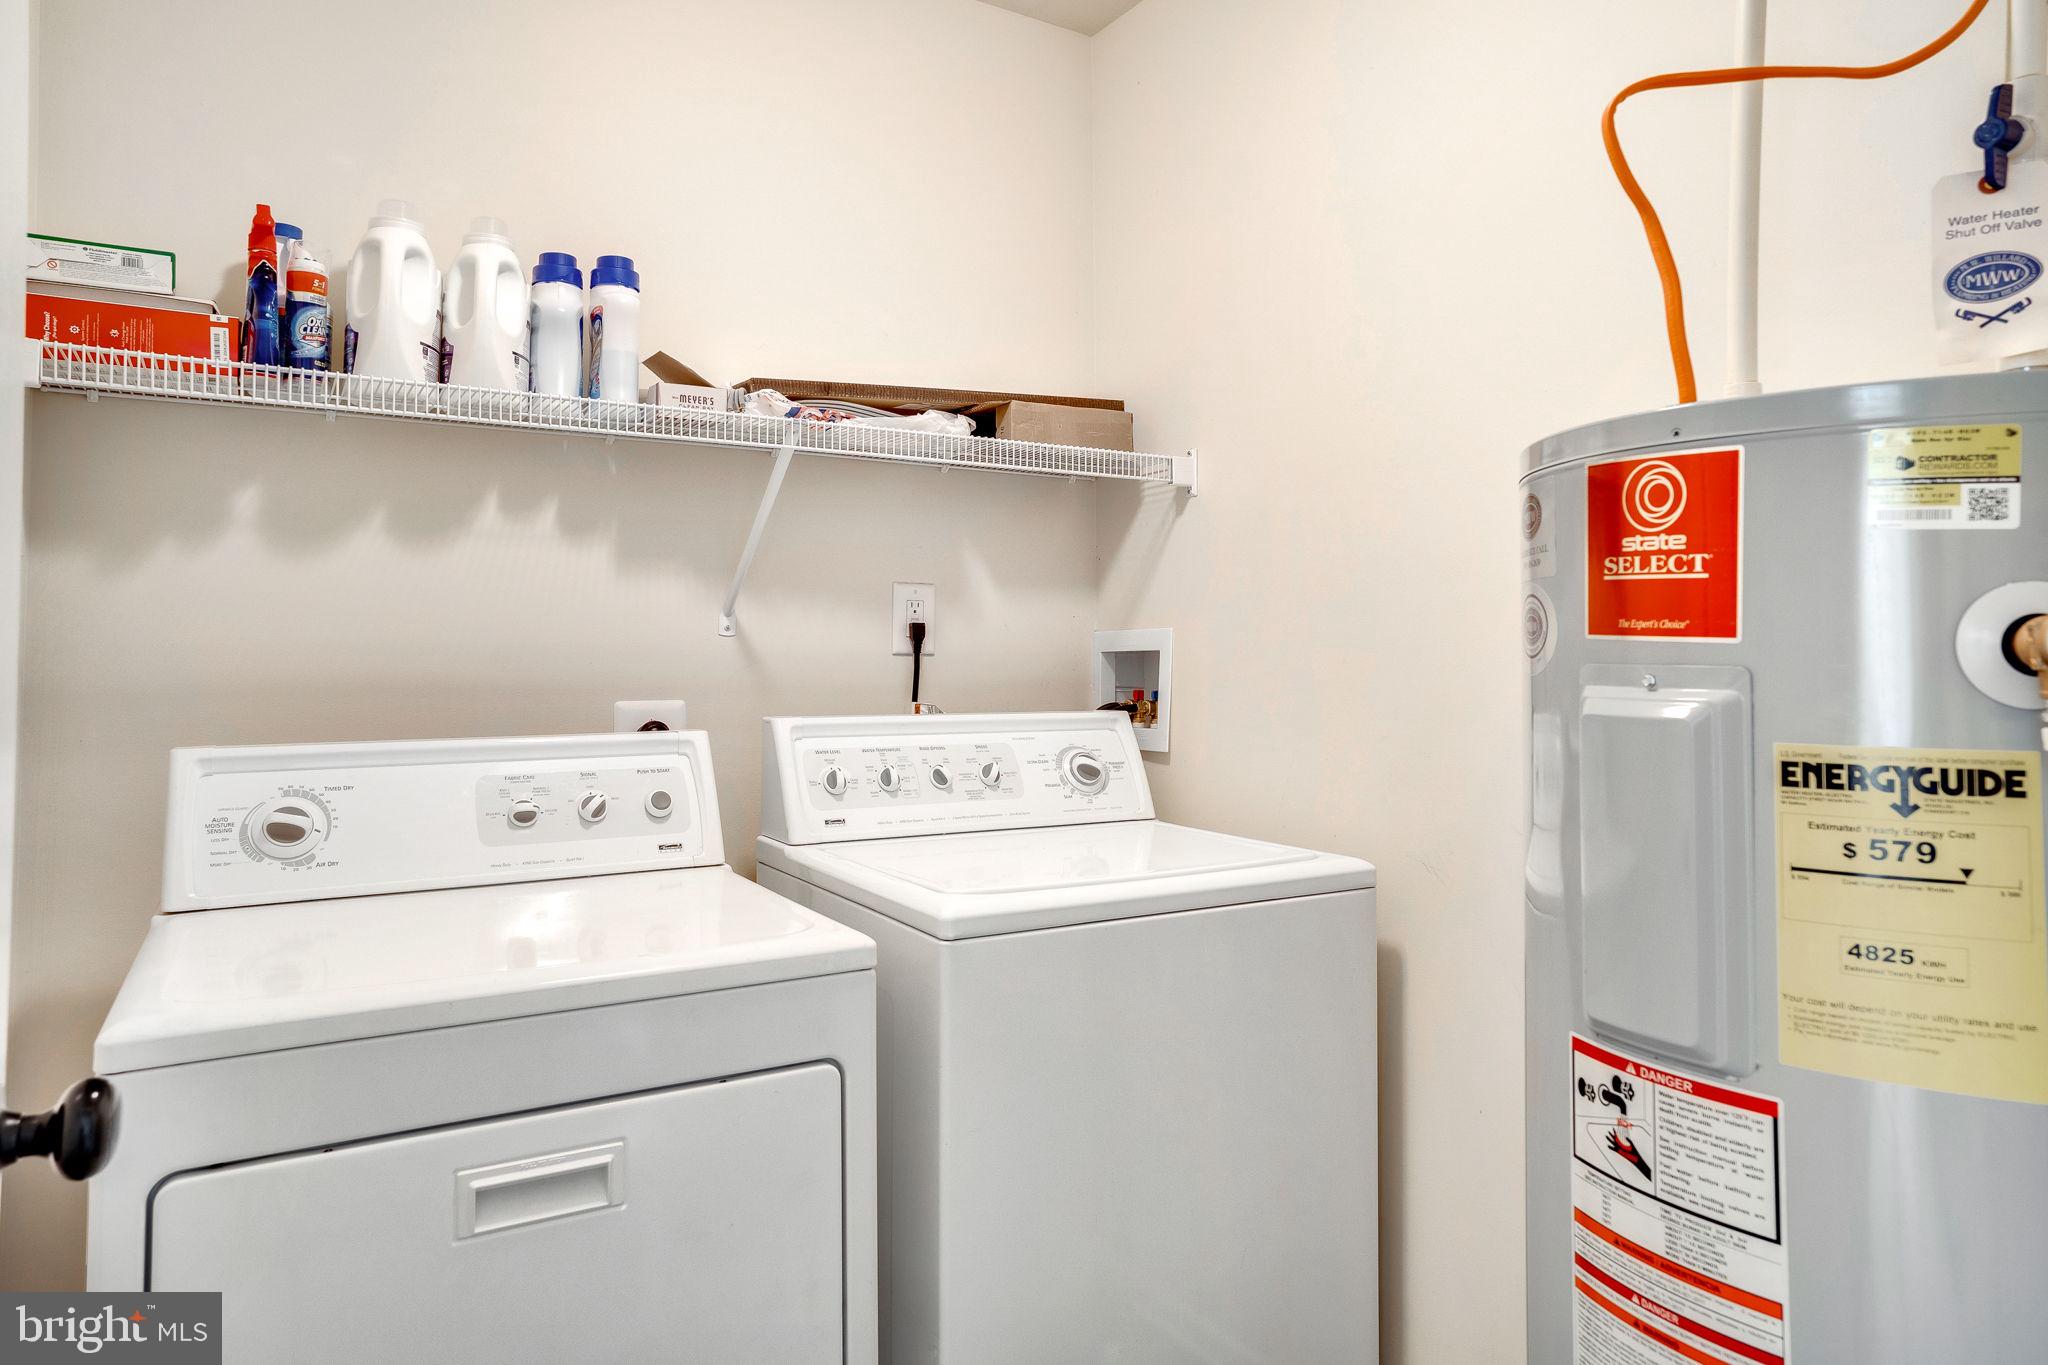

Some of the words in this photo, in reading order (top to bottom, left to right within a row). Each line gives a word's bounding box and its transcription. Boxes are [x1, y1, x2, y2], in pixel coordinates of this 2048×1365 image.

[1947, 214, 1988, 227] Water
[1991, 206, 2040, 220] Heater
[1945, 227, 1975, 240] Shut
[1980, 222, 2001, 235] Off
[2004, 218, 2042, 231] Valve
[1965, 268, 2021, 288] MWW
[307, 315, 325, 328] OXI
[679, 395, 714, 406] MEYER'S
[1918, 454, 1998, 463] CONTRACTOR
[1621, 533, 1688, 552] state
[1603, 553, 1711, 575] SELECT
[1618, 619, 1630, 628] The
[1630, 619, 1659, 630] Expert's
[1780, 760, 2028, 800] ENERGYGUIDE
[1807, 820, 1862, 832] Estimated
[1904, 828, 1945, 841] Energy
[1948, 829, 1976, 840] Cost
[1842, 842, 1857, 859] $
[1869, 838, 1937, 864] 579
[1847, 943, 1914, 965] 4825
[1844, 964, 1885, 974] Estimated
[1916, 972, 1946, 983] Energy
[1782, 992, 1804, 1003] Your
[1806, 997, 1827, 1007] cost
[1829, 1001, 1845, 1009] will
[1848, 1003, 1887, 1016] depend
[1890, 1009, 1902, 1017] on
[1905, 1012, 1929, 1021] your
[1932, 1014, 1960, 1025] utility
[1963, 1018, 1990, 1028] rates
[1994, 1021, 2015, 1030] and
[1639, 1066, 1694, 1094] DANGER
[1741, 1162, 1765, 1174] before
[1640, 1296, 1680, 1326] DANGER
